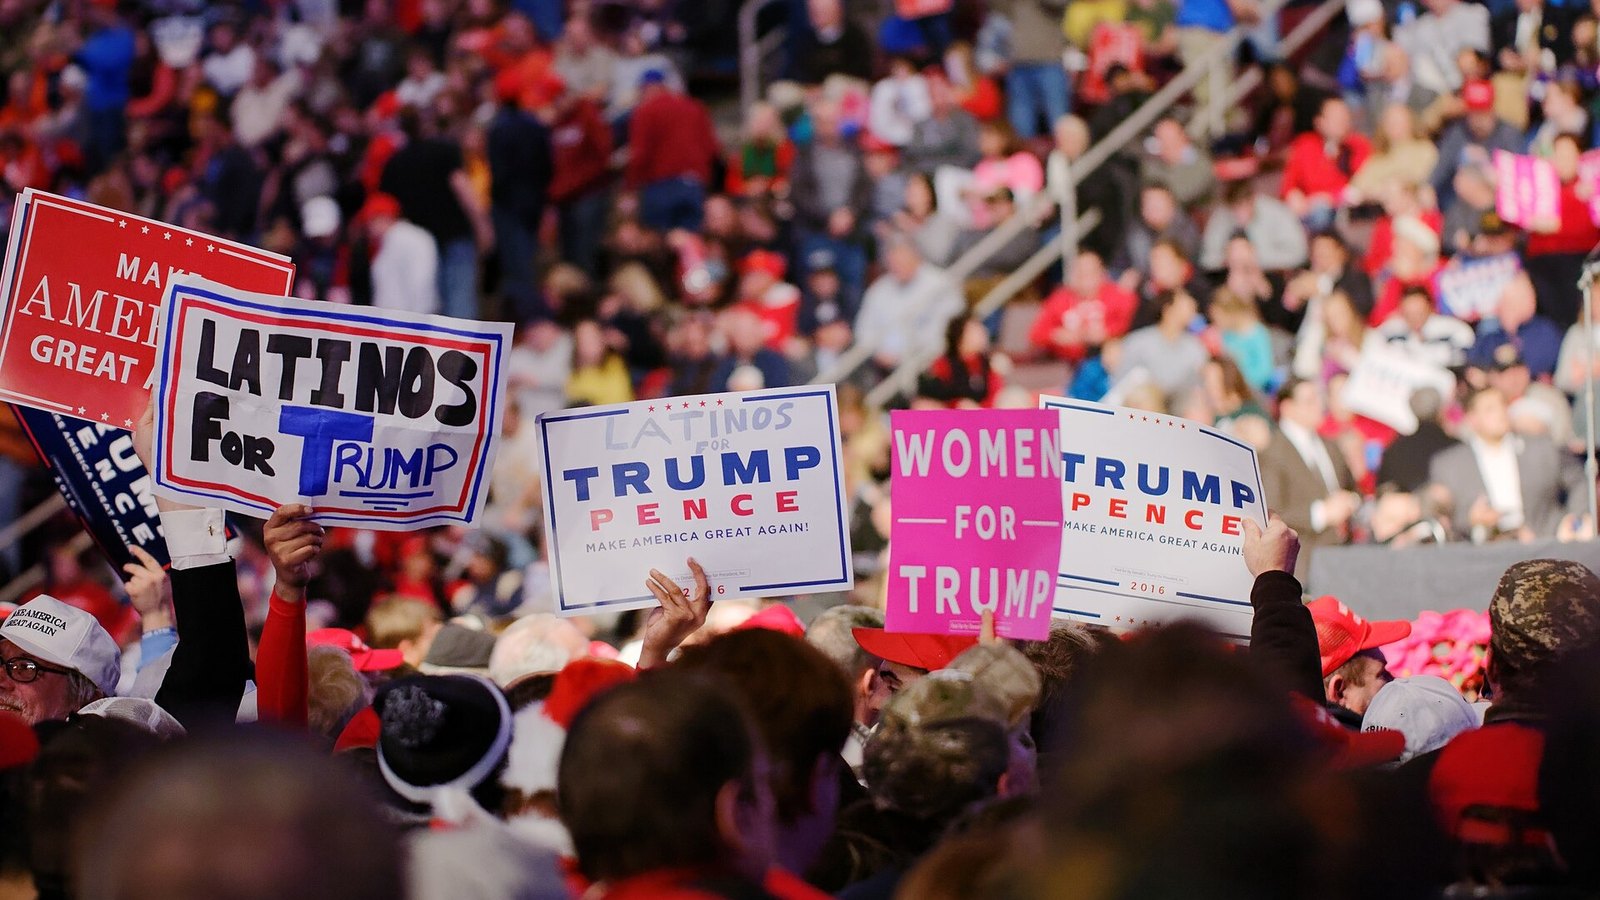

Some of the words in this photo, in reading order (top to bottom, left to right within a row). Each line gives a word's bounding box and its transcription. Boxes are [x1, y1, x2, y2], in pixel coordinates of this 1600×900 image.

[30, 334, 139, 384] GREAT
[197, 319, 477, 427] LATINOS
[604, 402, 794, 450] LATINOS
[695, 438, 730, 455] FOR
[62, 431, 93, 480] AMERICA
[91, 481, 115, 516] GREAT
[278, 405, 457, 496] TRUMP
[563, 446, 821, 501] TRUMP
[895, 428, 1061, 478] WOMEN
[1061, 452, 1256, 509] TRUMP
[590, 490, 799, 531] PENCE
[955, 505, 1016, 541] FOR
[1071, 492, 1242, 536] PENCE
[586, 538, 627, 553] MAKE
[632, 532, 699, 548] AMERICA
[705, 526, 752, 540] GREAT
[758, 522, 809, 536] AGAIN!
[1063, 521, 1097, 533] MAKE
[1100, 526, 1154, 542] AMERICA
[1159, 535, 1198, 549] GREAT
[900, 565, 1050, 619] TRUMP
[1131, 581, 1165, 594] 2016
[25, 609, 67, 630] AMERICA
[26, 621, 57, 636] AGAIN
